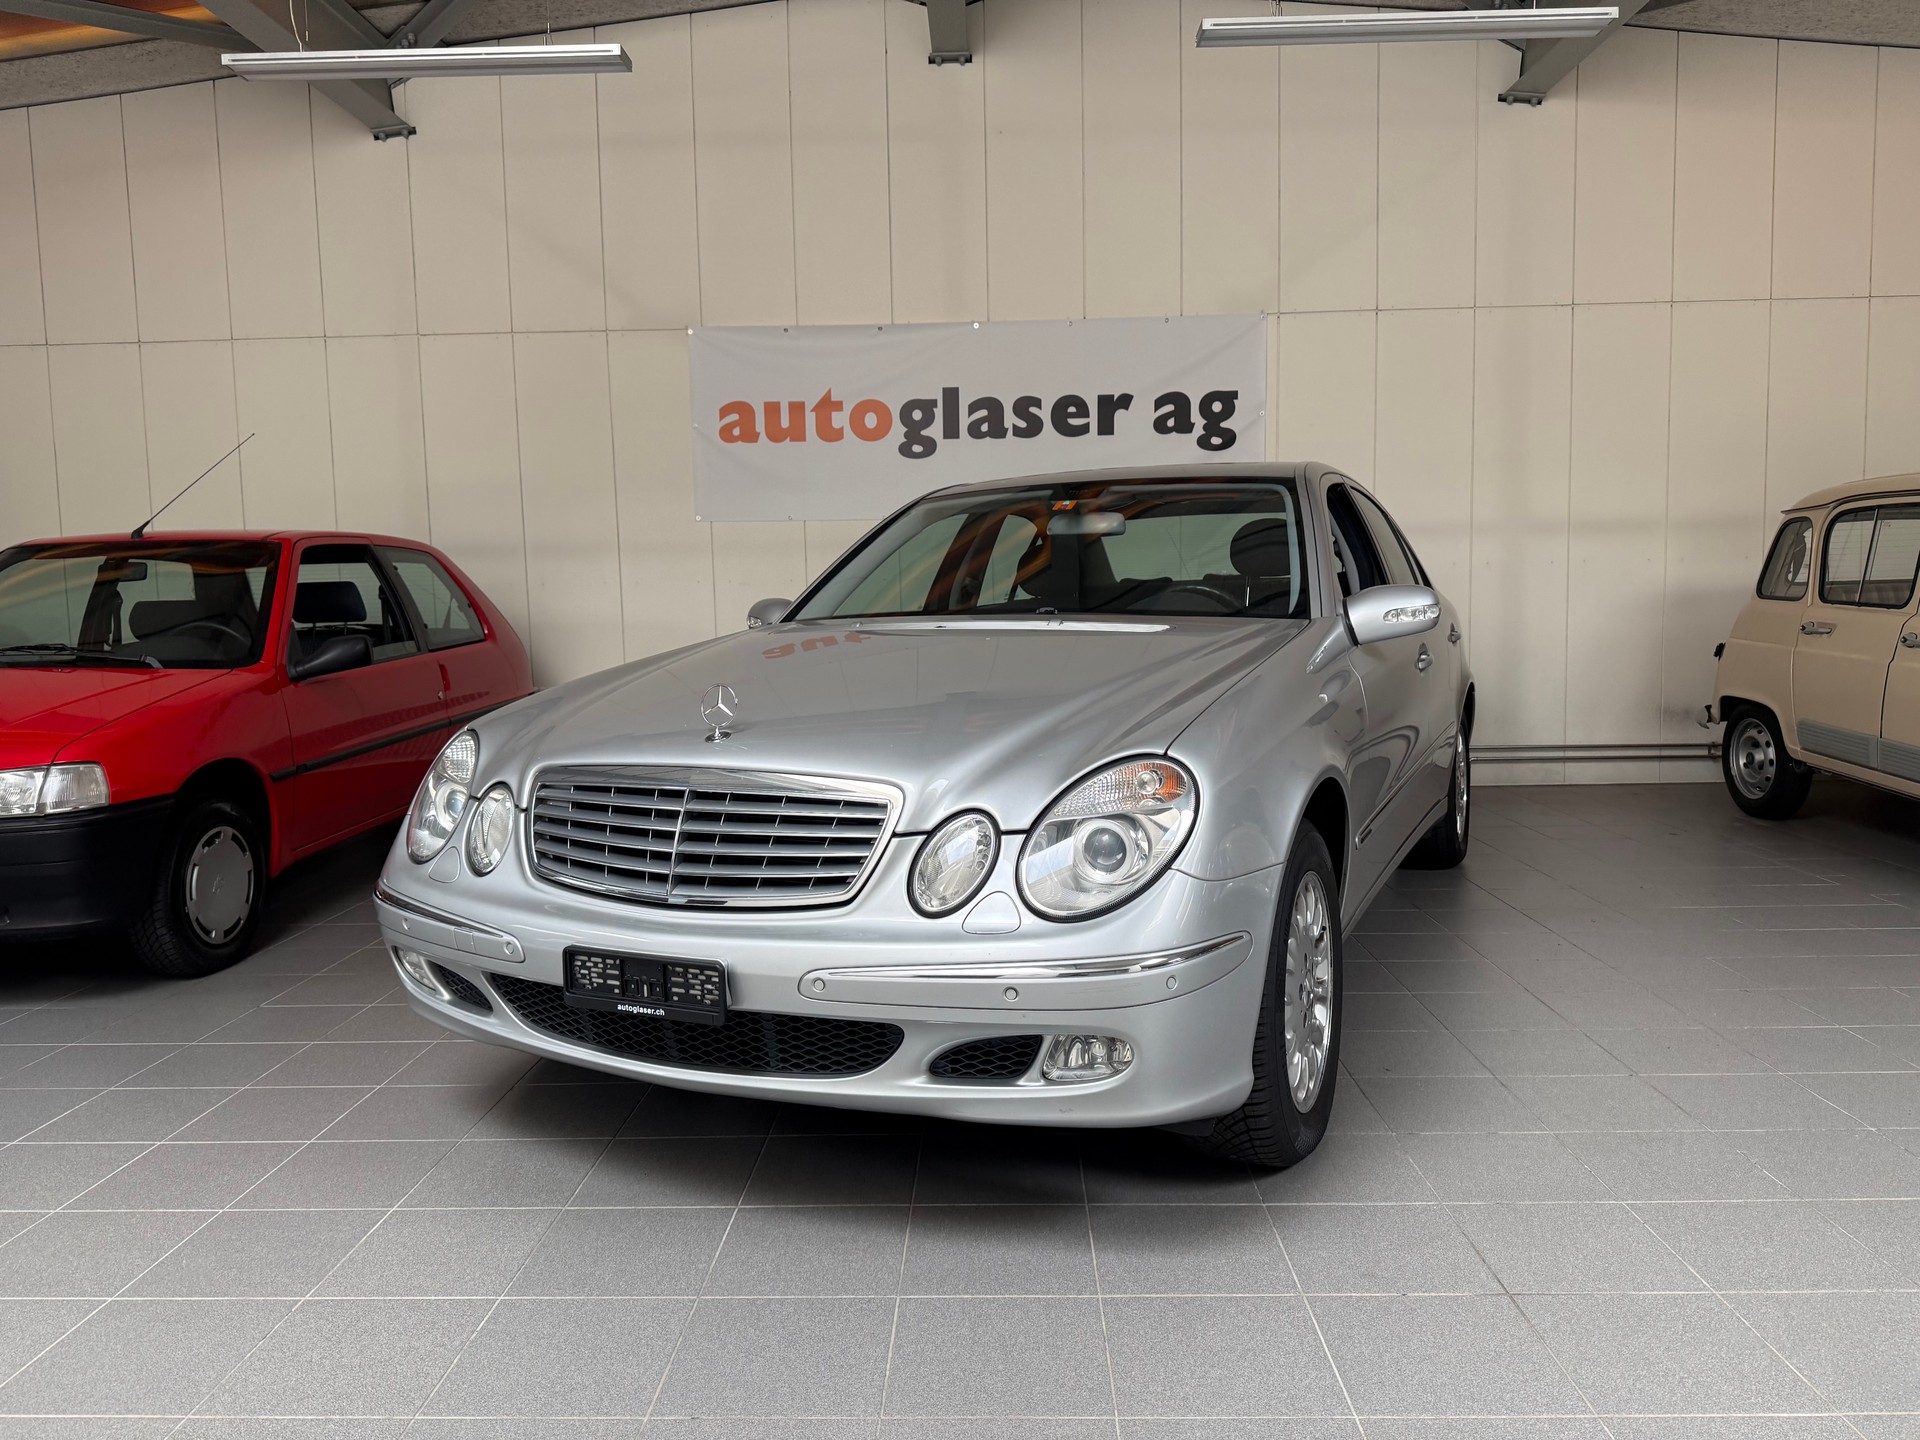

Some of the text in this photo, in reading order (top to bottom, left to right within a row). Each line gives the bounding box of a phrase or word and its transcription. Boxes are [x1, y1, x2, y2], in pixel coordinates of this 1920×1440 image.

[719, 387, 1238, 459] autoglaser ag
[617, 1003, 665, 1016] autoglaser.ch
